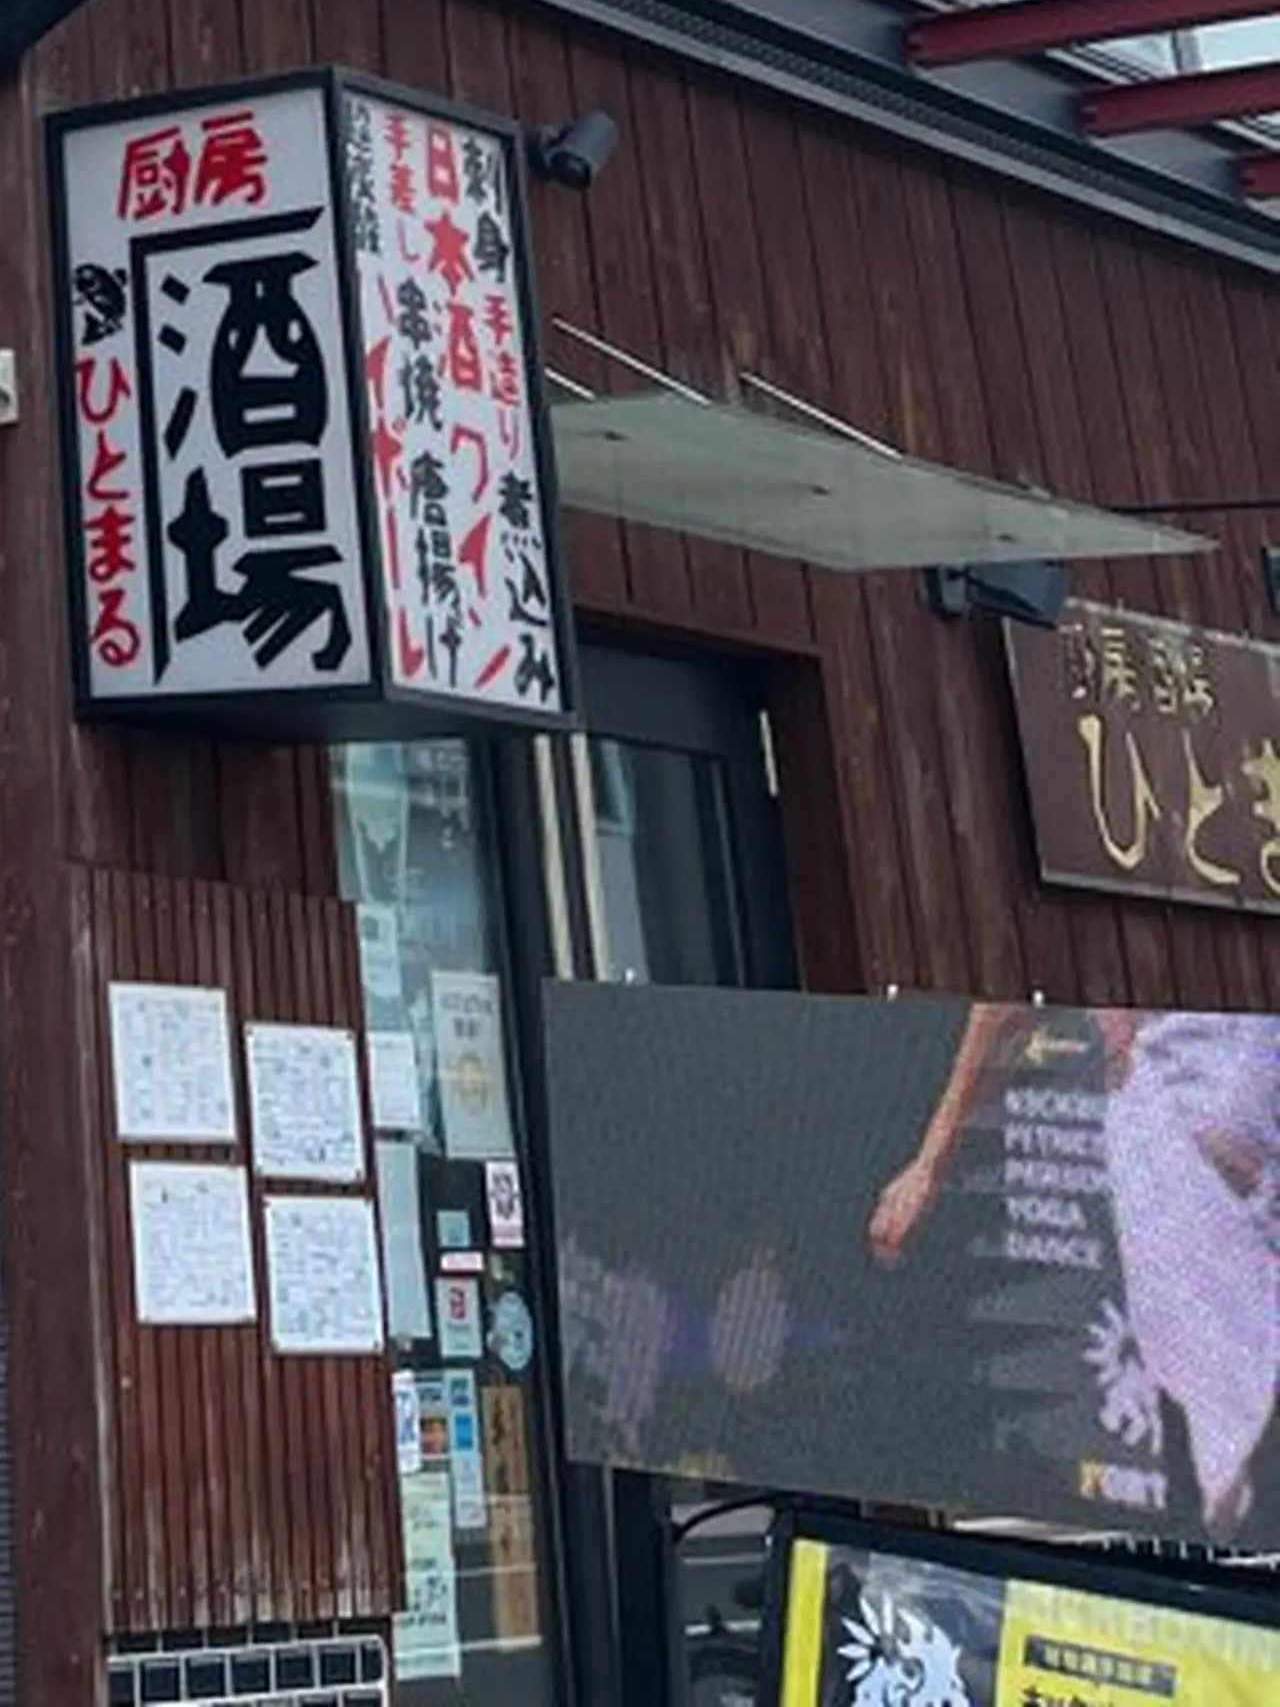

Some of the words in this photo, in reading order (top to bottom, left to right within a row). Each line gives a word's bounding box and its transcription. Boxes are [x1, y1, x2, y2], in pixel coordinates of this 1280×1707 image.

[118, 107, 269, 221] 厨房
[424, 121, 483, 393] 日本酒
[74, 357, 140, 669] ひとまる
[158, 250, 354, 671] 酒場
[410, 449, 462, 690] 唐揚げ
[449, 422, 512, 692] ワイン
[497, 469, 555, 705] 煮込み
